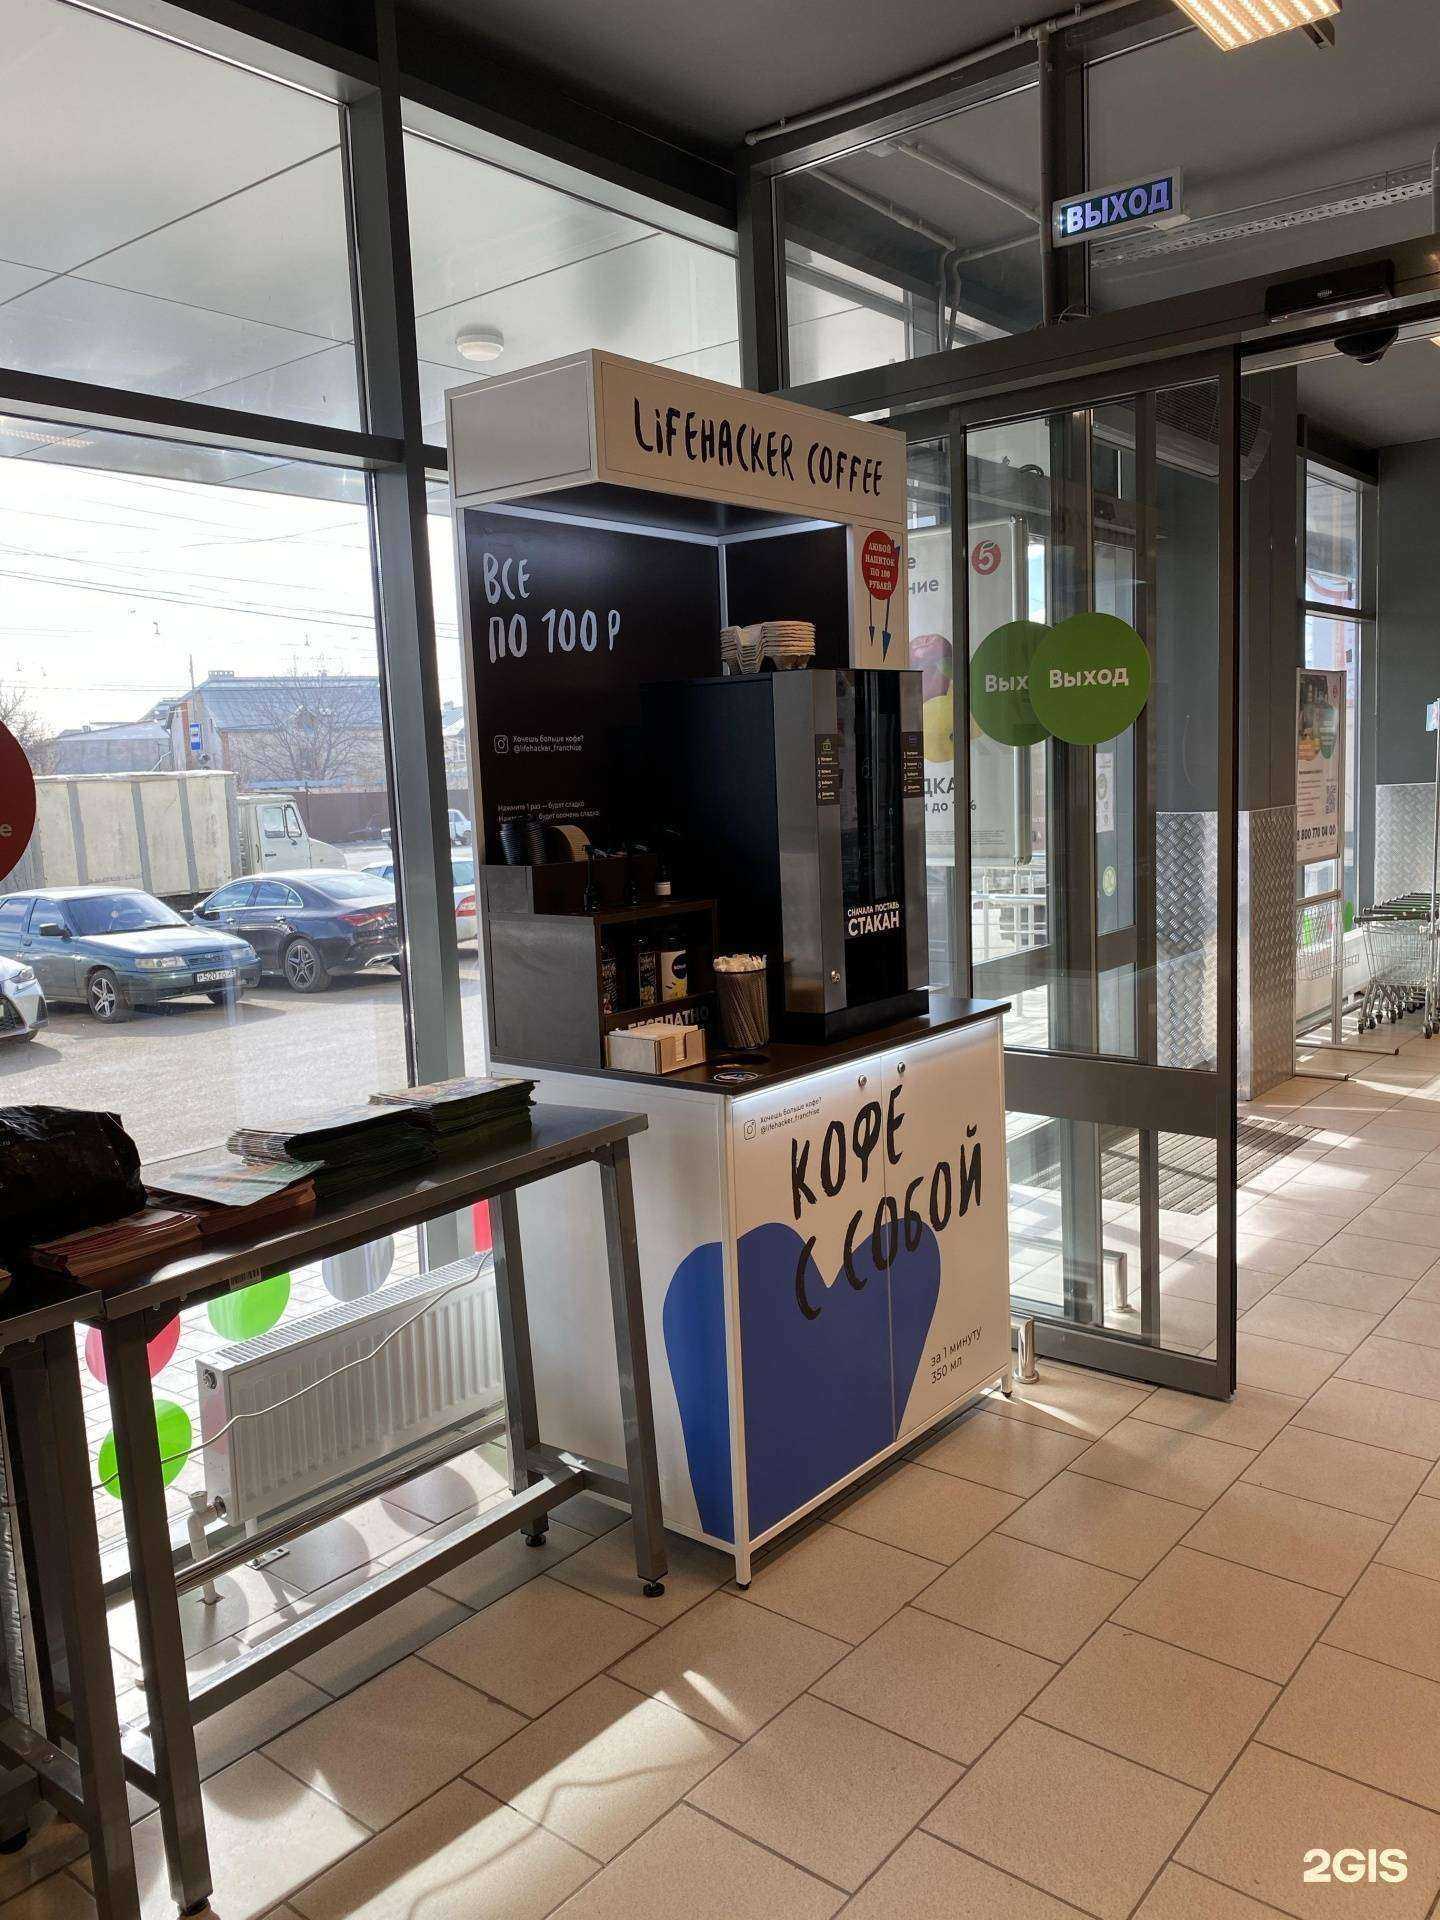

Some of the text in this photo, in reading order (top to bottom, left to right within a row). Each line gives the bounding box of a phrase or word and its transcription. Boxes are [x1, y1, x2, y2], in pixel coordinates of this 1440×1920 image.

[1067, 181, 1169, 234] ВЫХОД
[807, 443, 883, 497] COFFEE
[865, 554, 896, 567] НАПИТОК
[868, 542, 892, 553] ЛЮБОЙ
[483, 553, 530, 604] ВСЕ
[869, 580, 893, 590] РУБЛЕЙ
[870, 568, 891, 578] ПО 100
[489, 609, 621, 664] ПО 100 Р
[1049, 667, 1129, 689] Выход
[847, 901, 900, 917] СНАЧАЛА ПОСТАВЬ
[848, 911, 900, 937] СТАКАН
[760, 1097, 822, 1123] Хочешь больше кофе?
[791, 1084, 905, 1220] КОФЕ
[796, 1123, 982, 1320] С СОБОЙ
[931, 1354, 943, 1366] за
[950, 1326, 982, 1355] минуту
[931, 1356, 963, 1385] 350 мл
